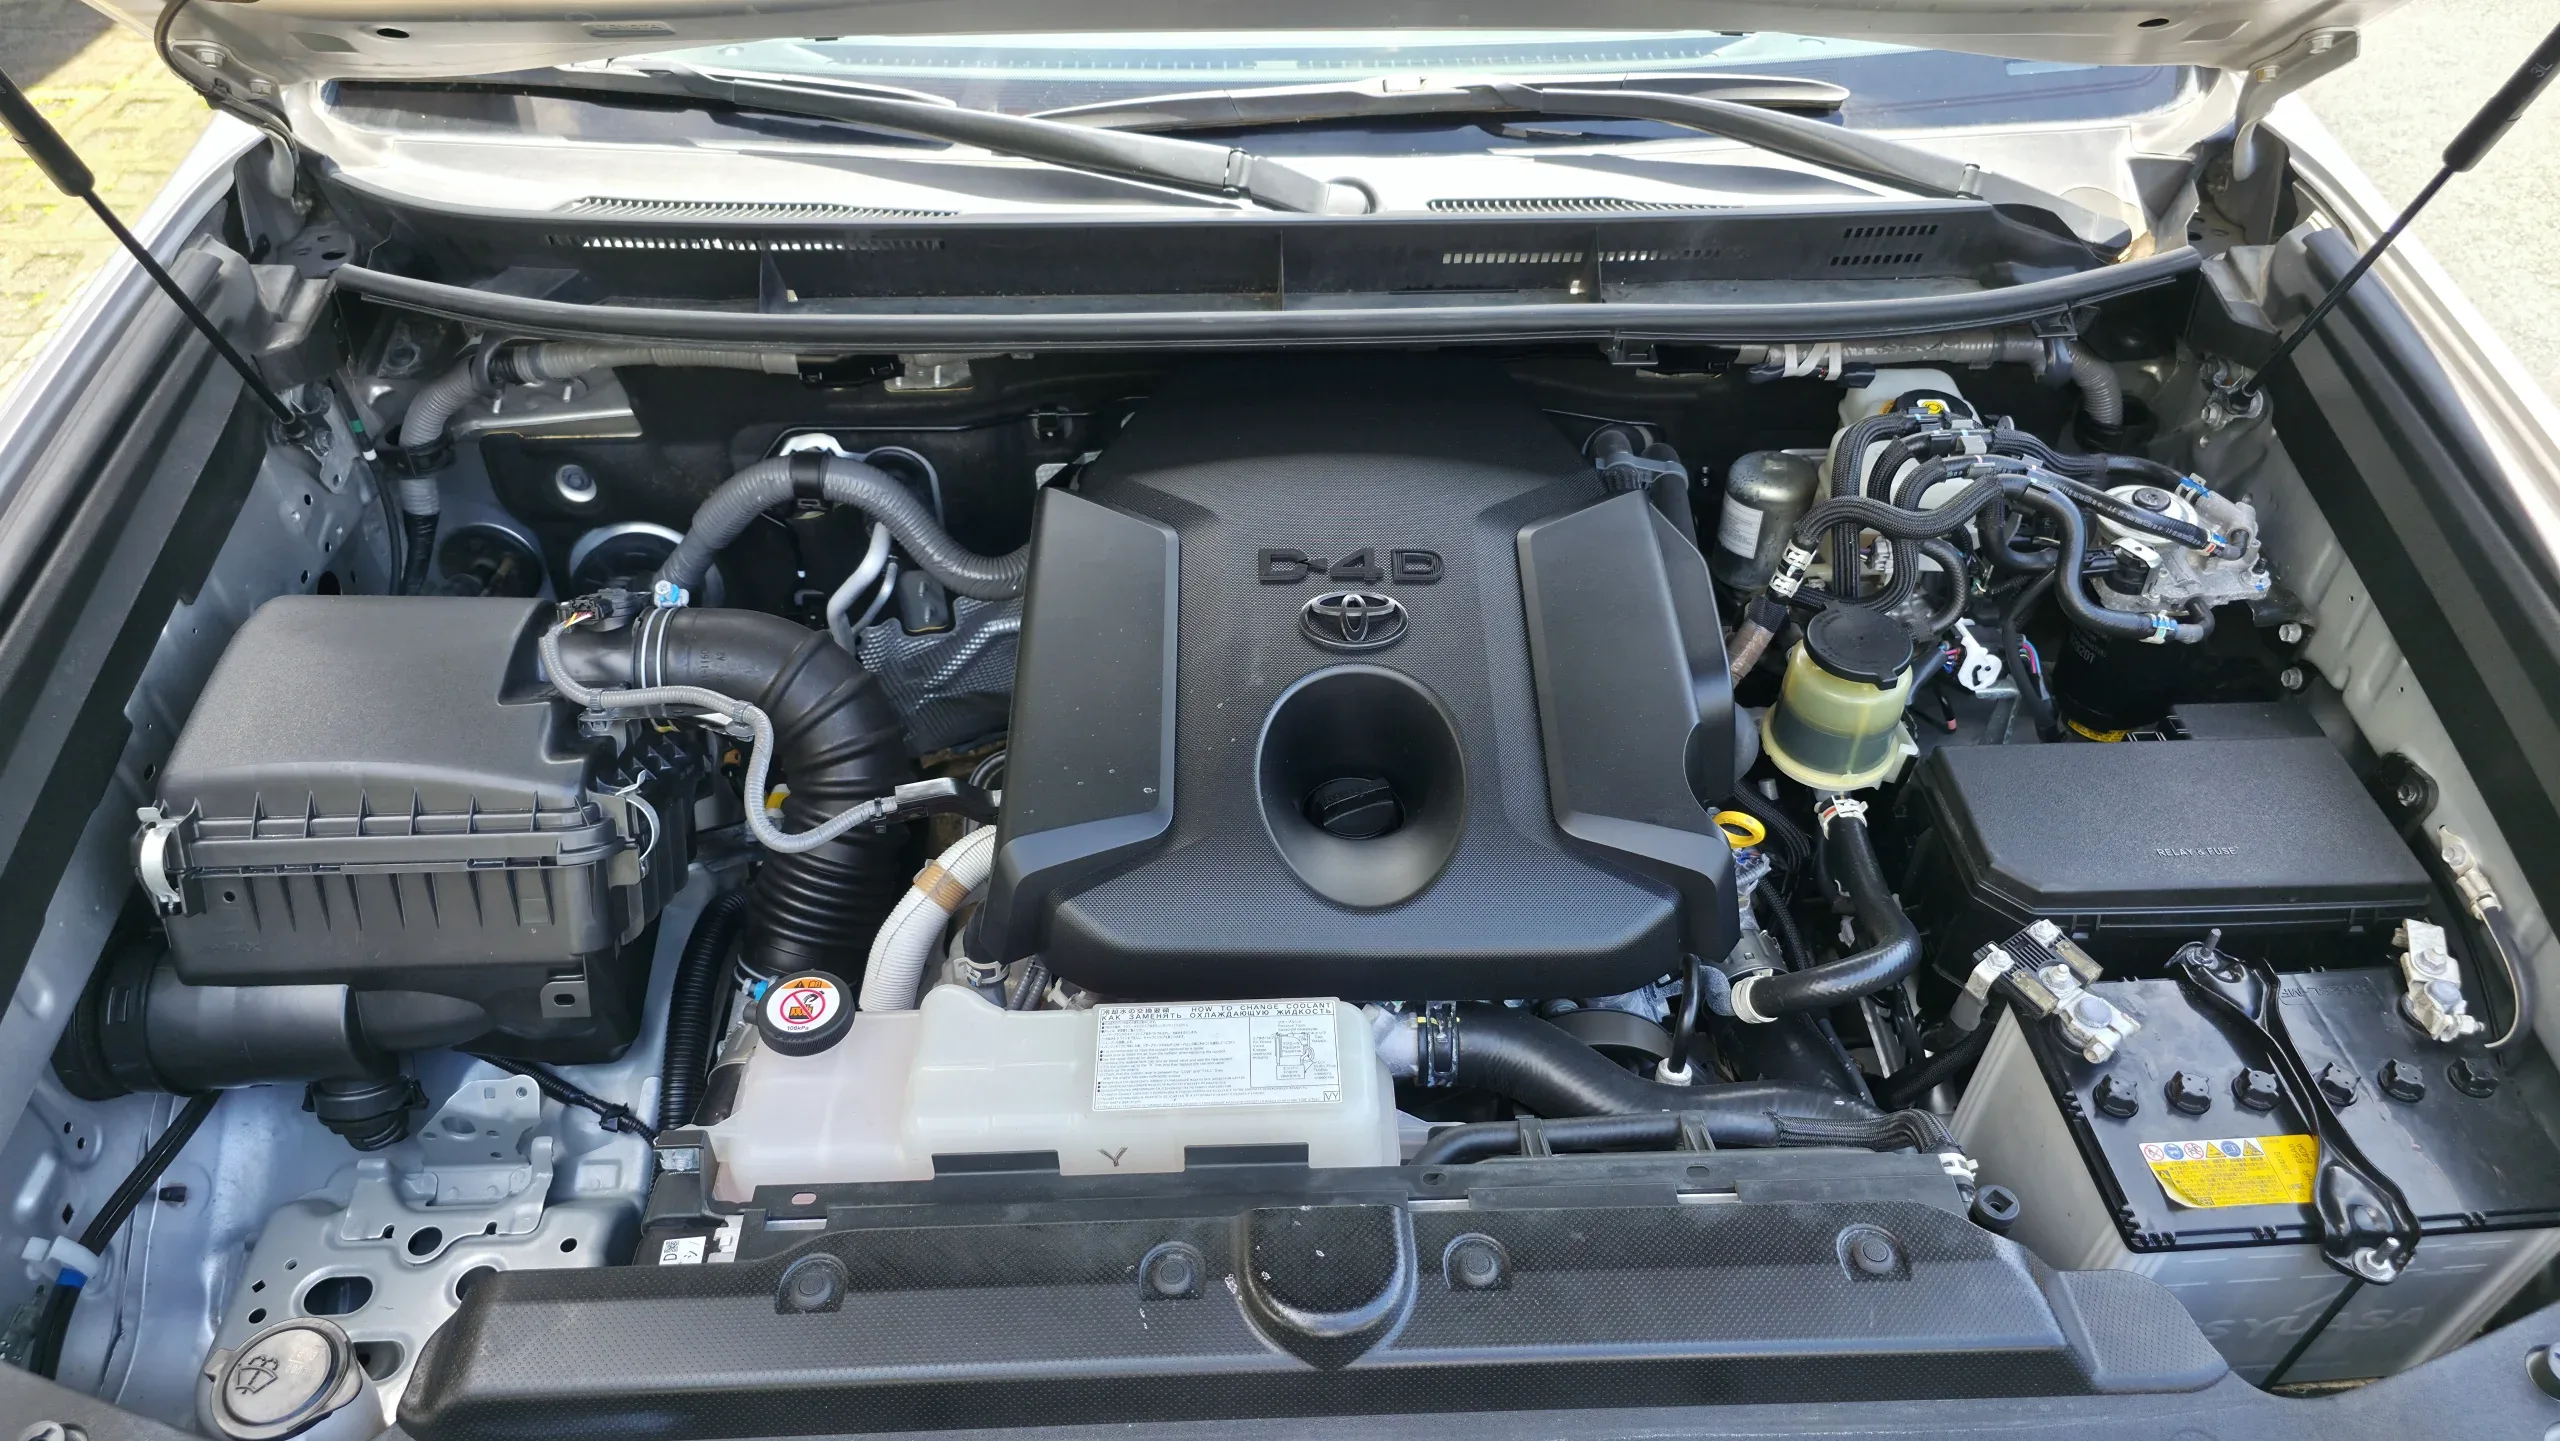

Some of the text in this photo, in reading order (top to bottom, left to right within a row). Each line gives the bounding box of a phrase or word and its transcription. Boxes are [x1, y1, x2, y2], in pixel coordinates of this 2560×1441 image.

[2531, 62, 2554, 78] 3L
[2156, 846, 2238, 858] RELAY & FUSE
[1240, 1003, 1279, 1011] CHANGE
[1286, 1002, 1331, 1010] COOLANT
[1128, 1012, 1182, 1020] ЗАМЕНЯТЬ
[1189, 1010, 1270, 1019] ОХЛАЖДАЮЩУЮ
[1276, 1008, 1332, 1016] ЖИДКОСТЬ
[1324, 1092, 1338, 1100] VY
[1097, 1146, 1128, 1167] Y
